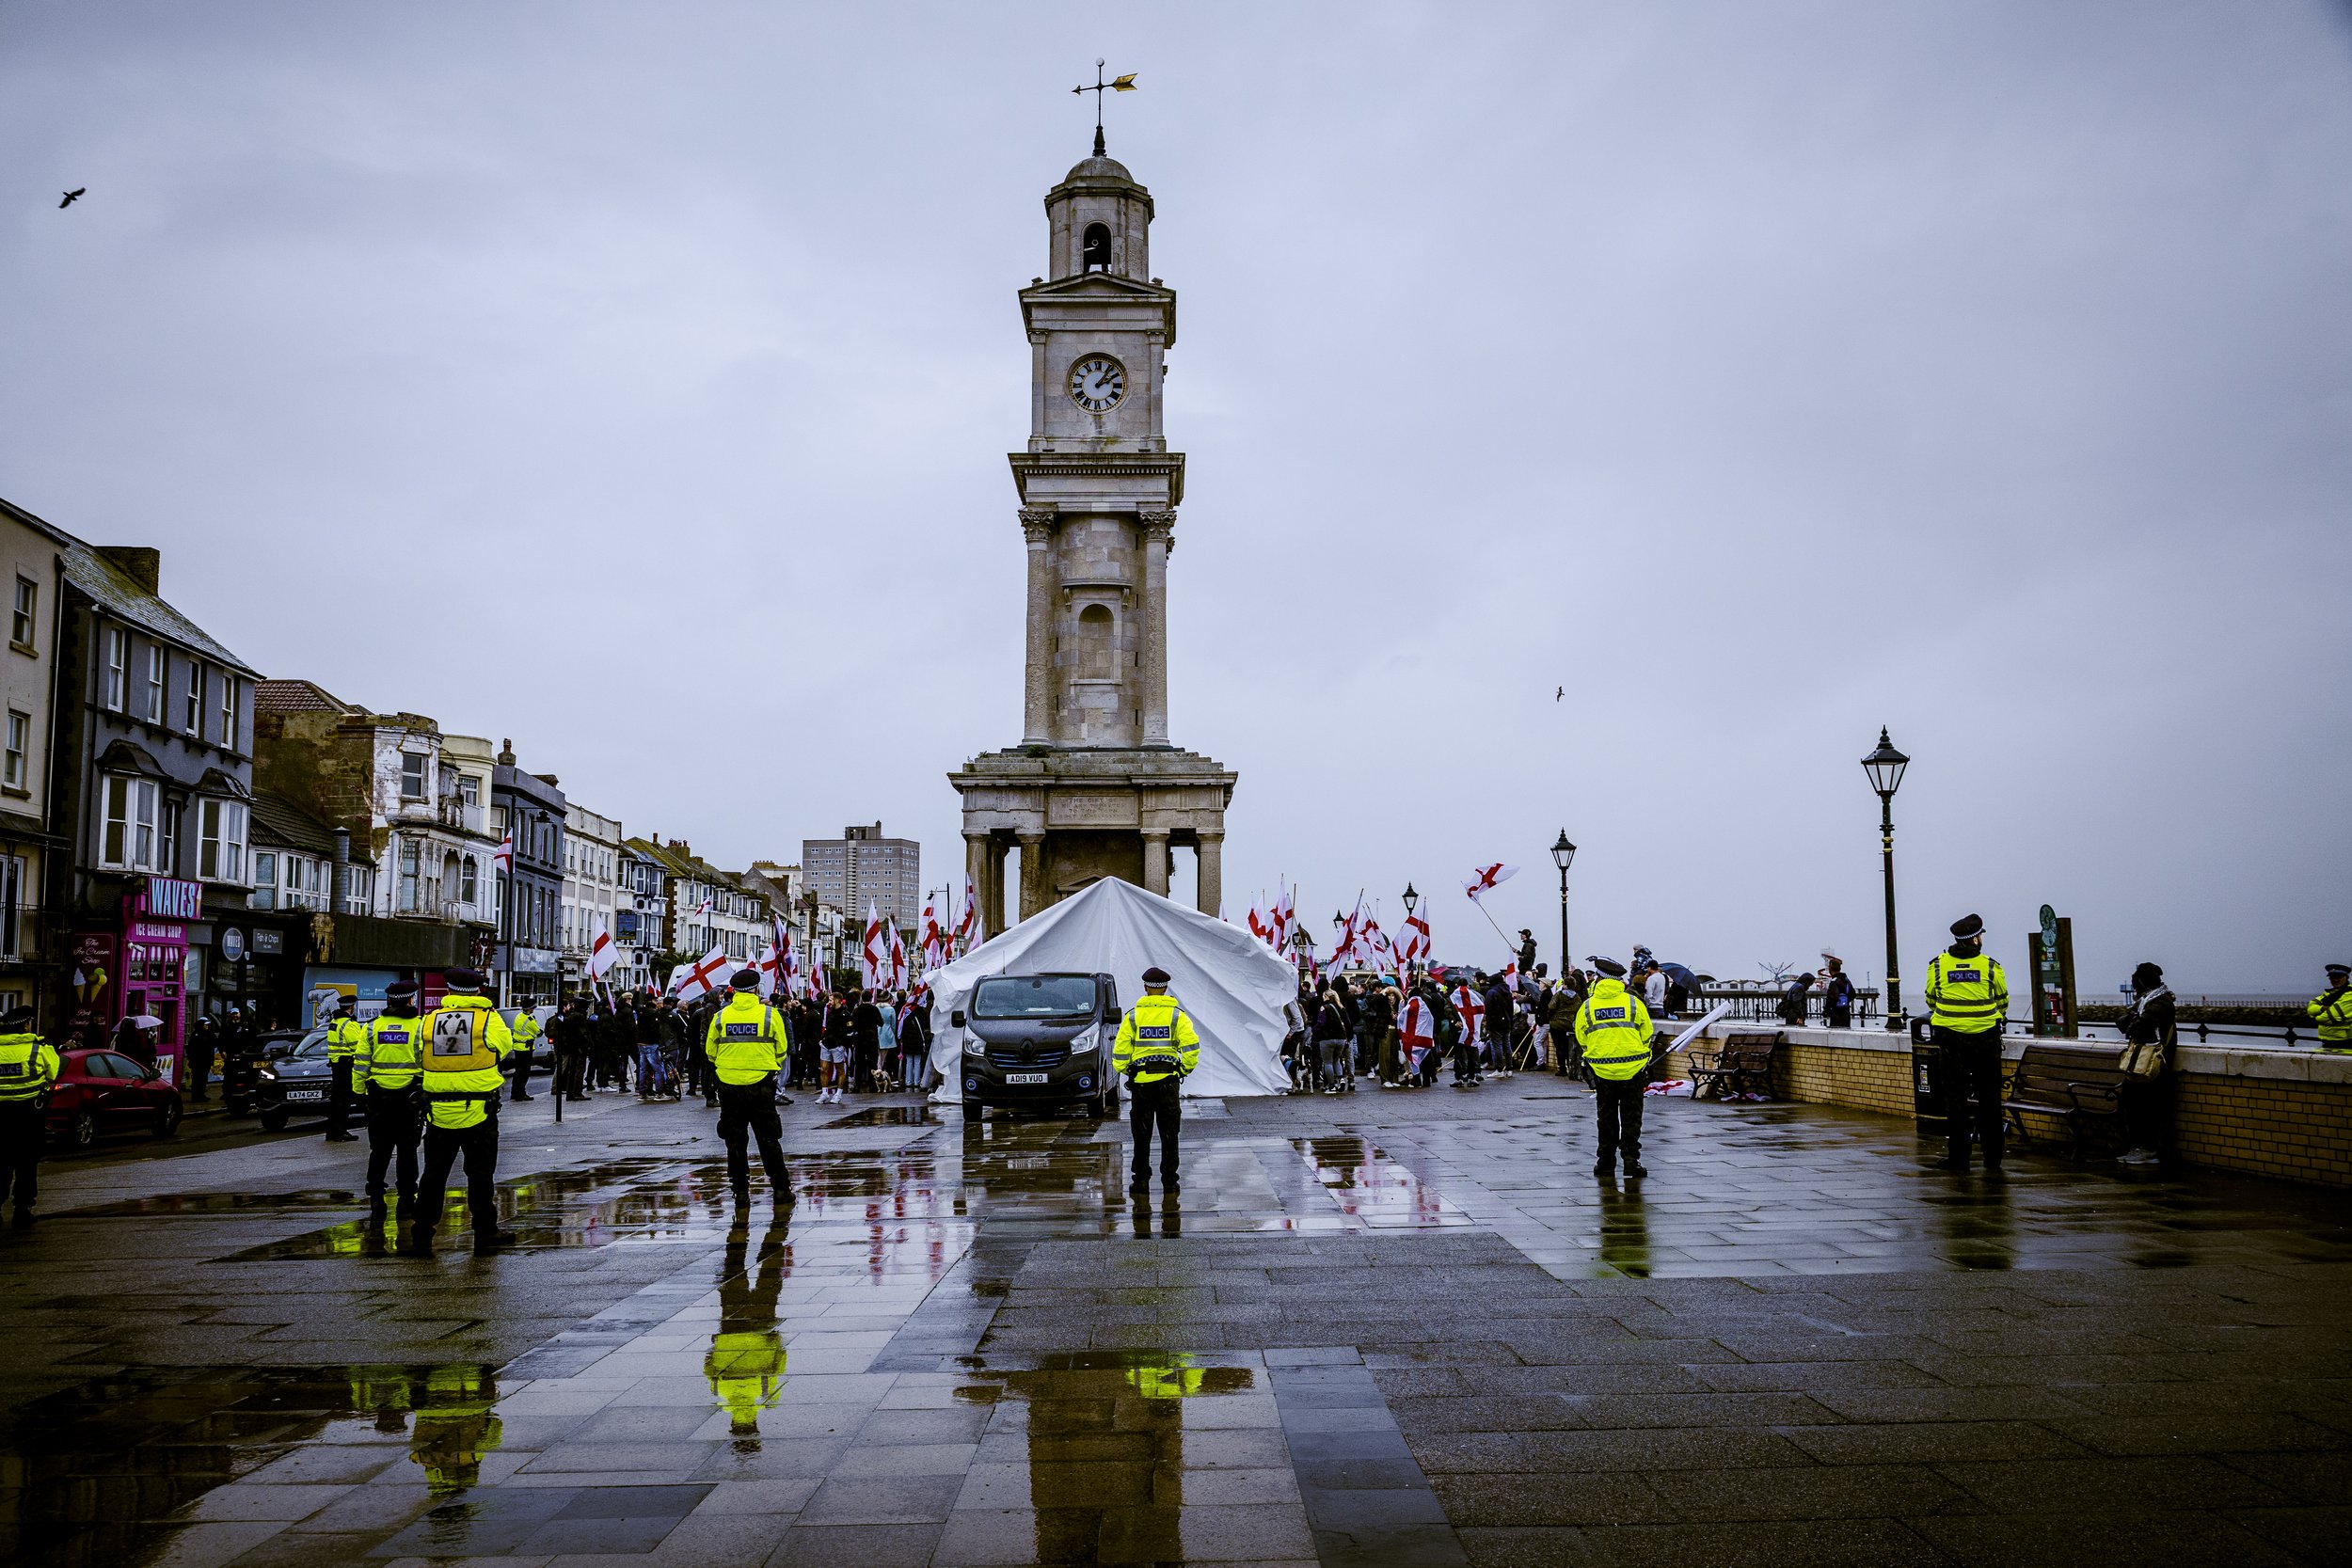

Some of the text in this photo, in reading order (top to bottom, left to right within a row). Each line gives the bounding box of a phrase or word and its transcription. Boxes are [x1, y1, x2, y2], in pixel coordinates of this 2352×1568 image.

[151, 878, 196, 918] WAVES
[135, 923, 182, 938] ICE CREAM SHOP
[86, 938, 99, 946] The
[73, 946, 85, 956] Ice
[82, 956, 100, 964] Shop
[1948, 973, 1979, 981] POLICE
[1596, 1008, 1624, 1020] POLICE
[727, 1025, 756, 1035] POLICE
[1140, 1028, 1168, 1037] POLICE
[446, 1037, 457, 1053] 2
[1029, 1074, 1043, 1083] VUO
